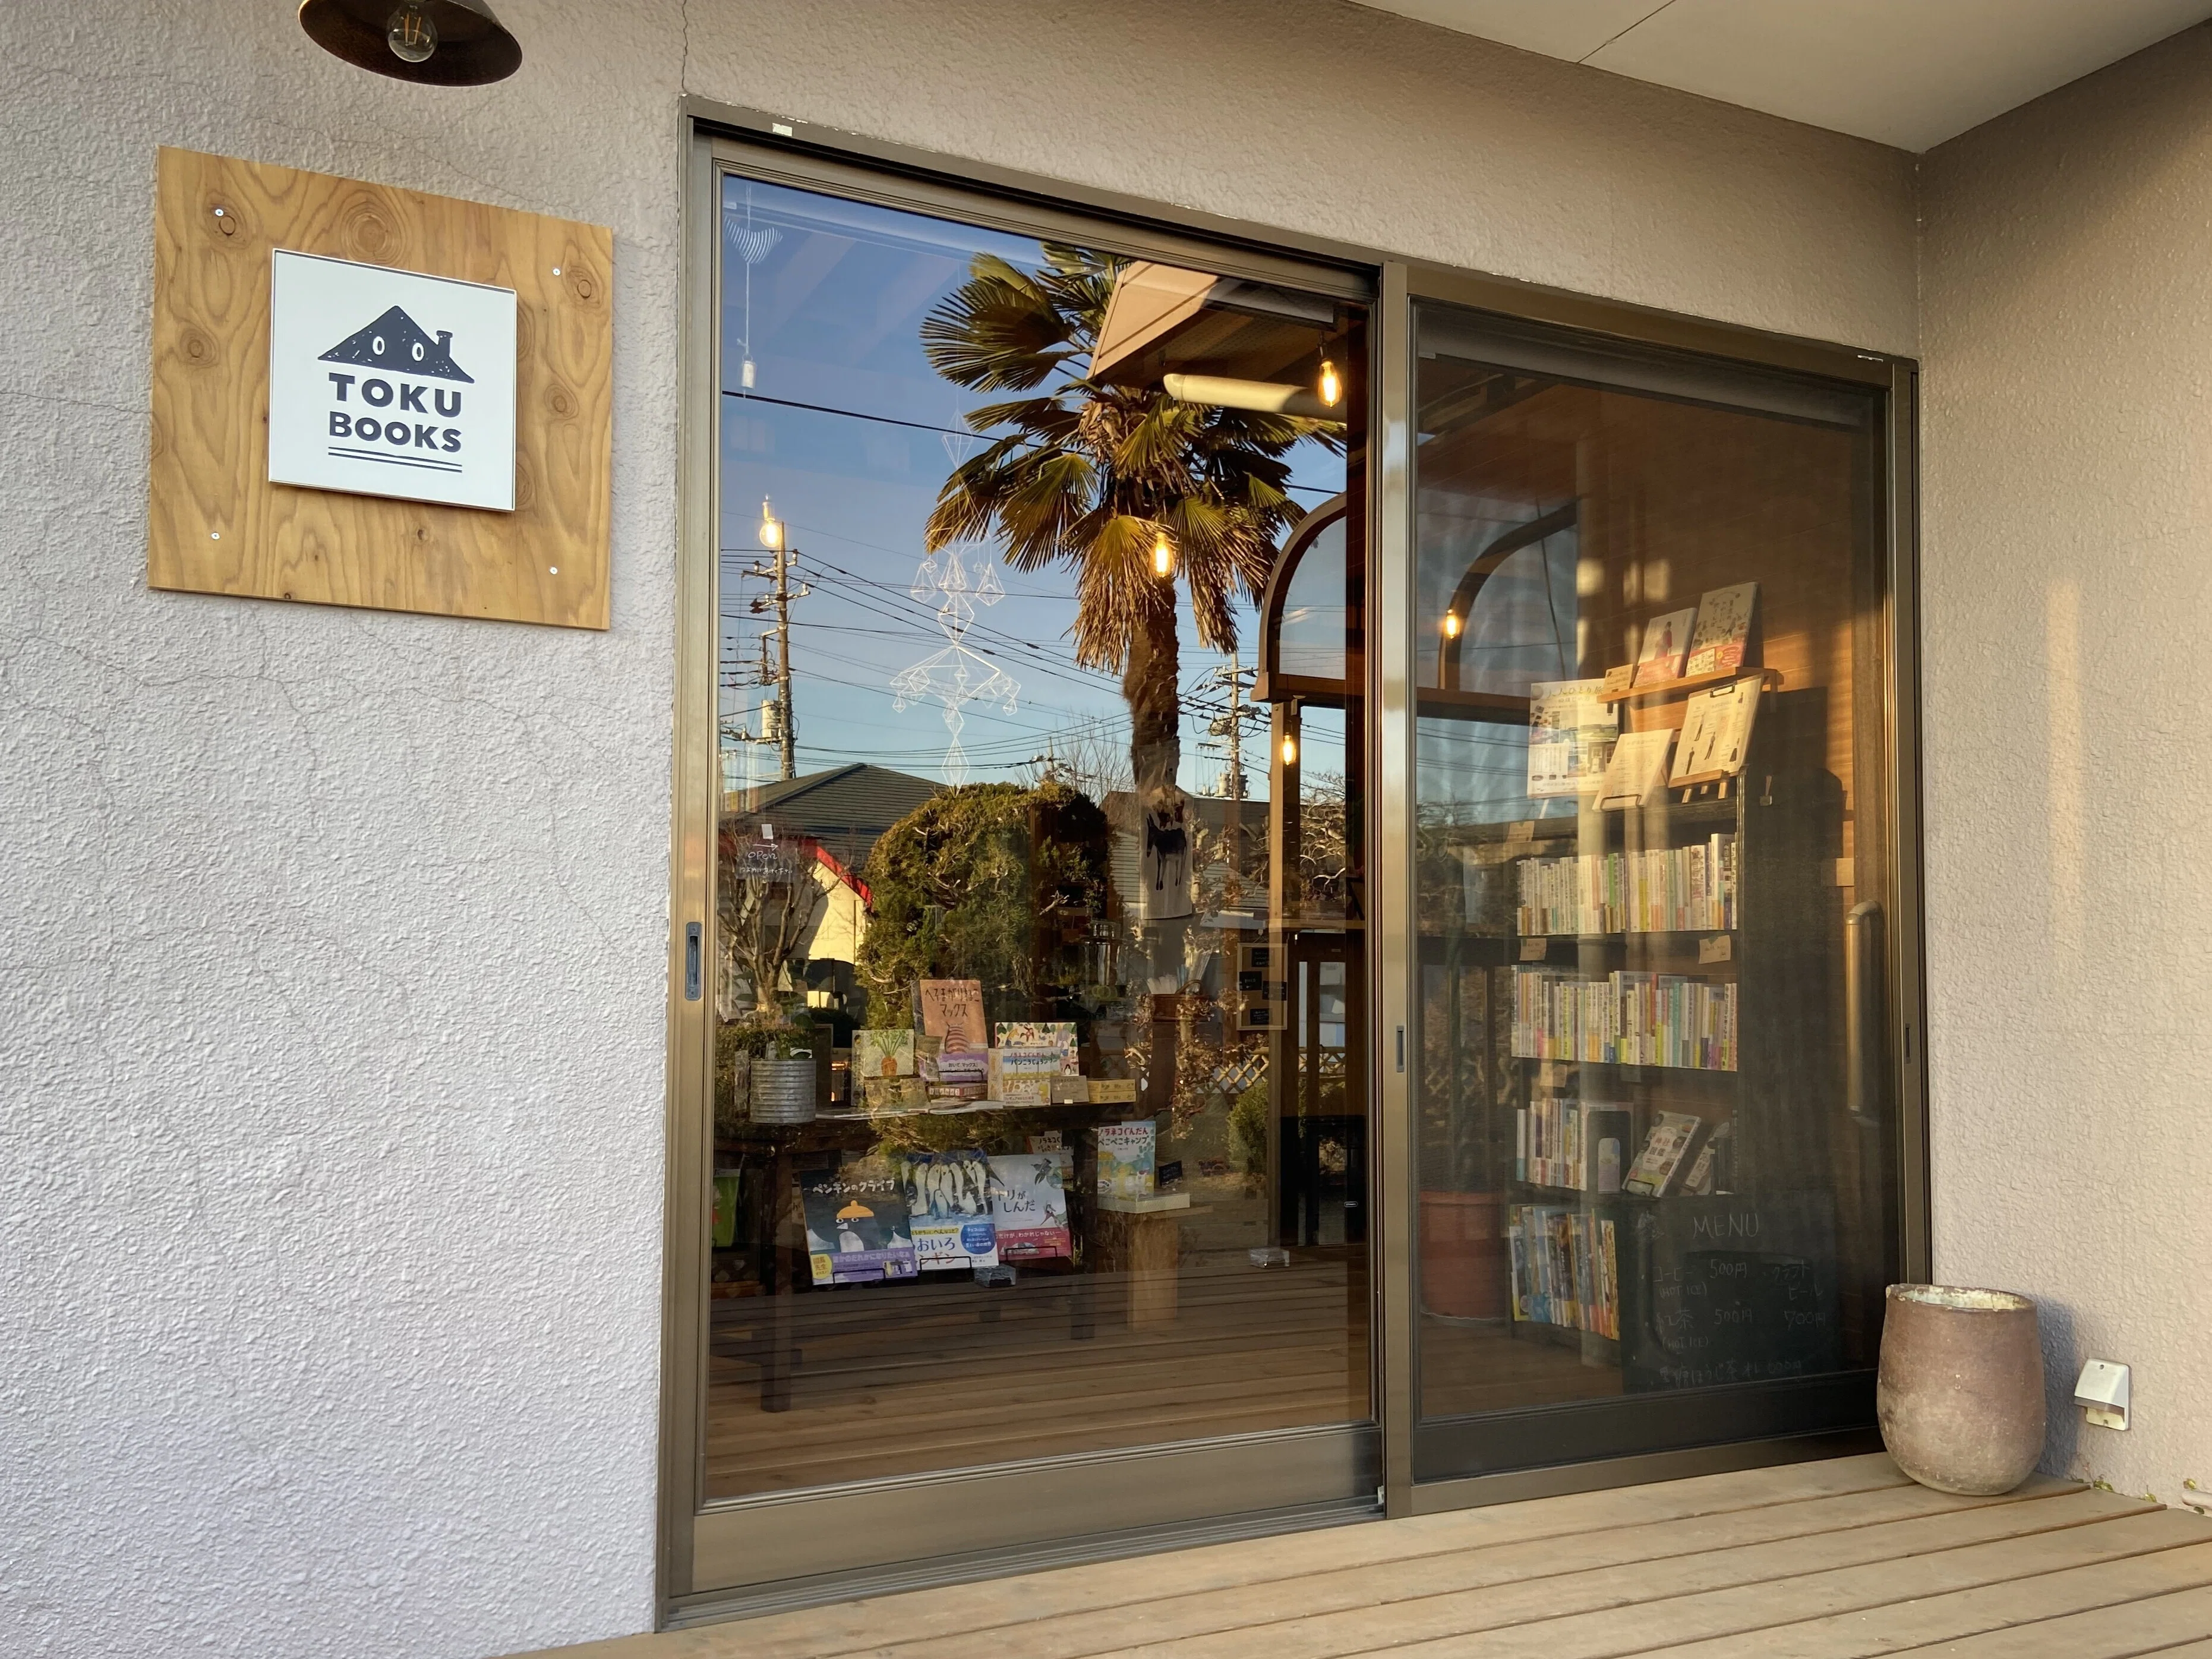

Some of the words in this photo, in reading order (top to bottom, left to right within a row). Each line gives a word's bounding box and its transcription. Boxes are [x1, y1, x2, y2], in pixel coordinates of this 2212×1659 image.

[329, 372, 462, 417] TOKU
[329, 411, 462, 453] BOOKS
[939, 1004, 968, 1017] マックス
[1099, 1127, 1148, 1136] ノラネコぐんだん
[1098, 1136, 1150, 1146] ぺこぺこキャンプ
[1004, 1199, 1036, 1213] しんだ
[1693, 1212, 1760, 1239] MENU
[914, 1237, 955, 1252] おいろ
[917, 1251, 955, 1265] ンギン
[1710, 1259, 1747, 1279] 500円
[1714, 1308, 1752, 1326] 500円
